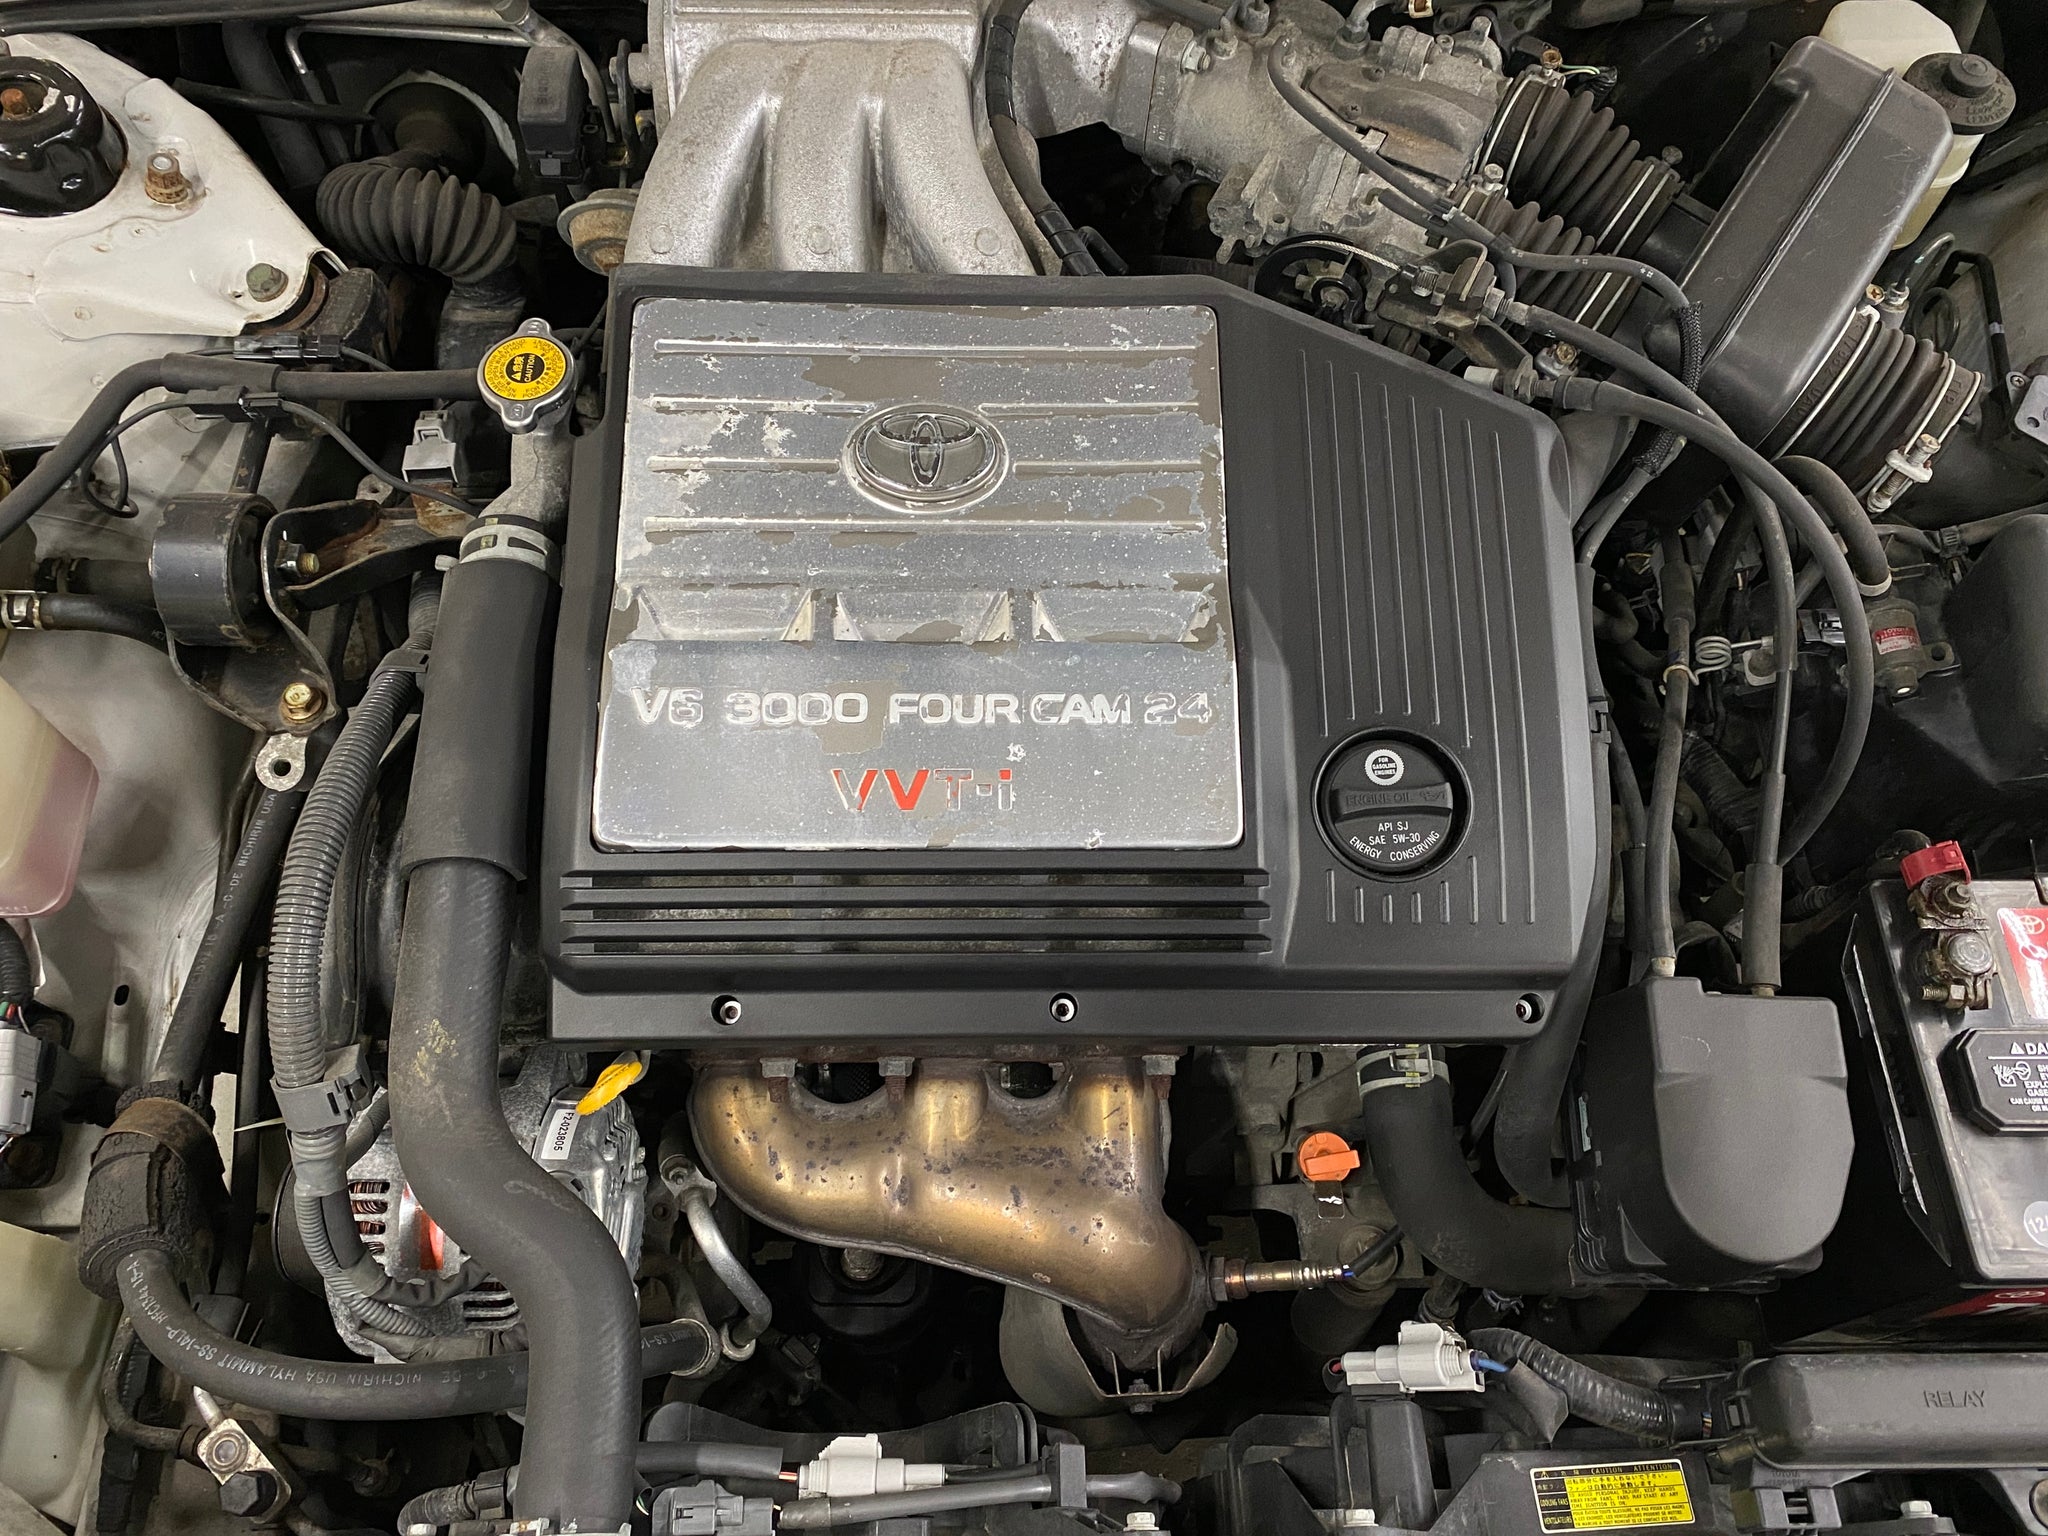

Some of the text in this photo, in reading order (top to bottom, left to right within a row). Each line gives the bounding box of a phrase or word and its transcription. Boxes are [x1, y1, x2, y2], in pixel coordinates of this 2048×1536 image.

[524, 354, 535, 382] CAUTION
[630, 687, 1212, 728] V6 3000 FOUR CAM 24
[830, 768, 1012, 811] VVT-i
[1345, 792, 1409, 809] ENGINE OIL
[237, 819, 266, 867] NICHIRIN
[261, 793, 278, 814] USA
[1378, 821, 1409, 832] API SJ
[1349, 830, 1440, 861] ENERGY CONSERVING
[1368, 832, 1421, 846] SAE 5W-30
[554, 1112, 575, 1152] F2-023805
[216, 1353, 297, 1381] HYLAMMIT
[306, 1369, 337, 1385] USA
[347, 1372, 422, 1387] NICHIRIN
[1923, 1389, 1985, 1408] RELAY
[1590, 1463, 1672, 1474] CAUTION ATTENTION
[1539, 1497, 1568, 1506] COOLING FANS
[1543, 1516, 1572, 1525] VENTILATEURS
